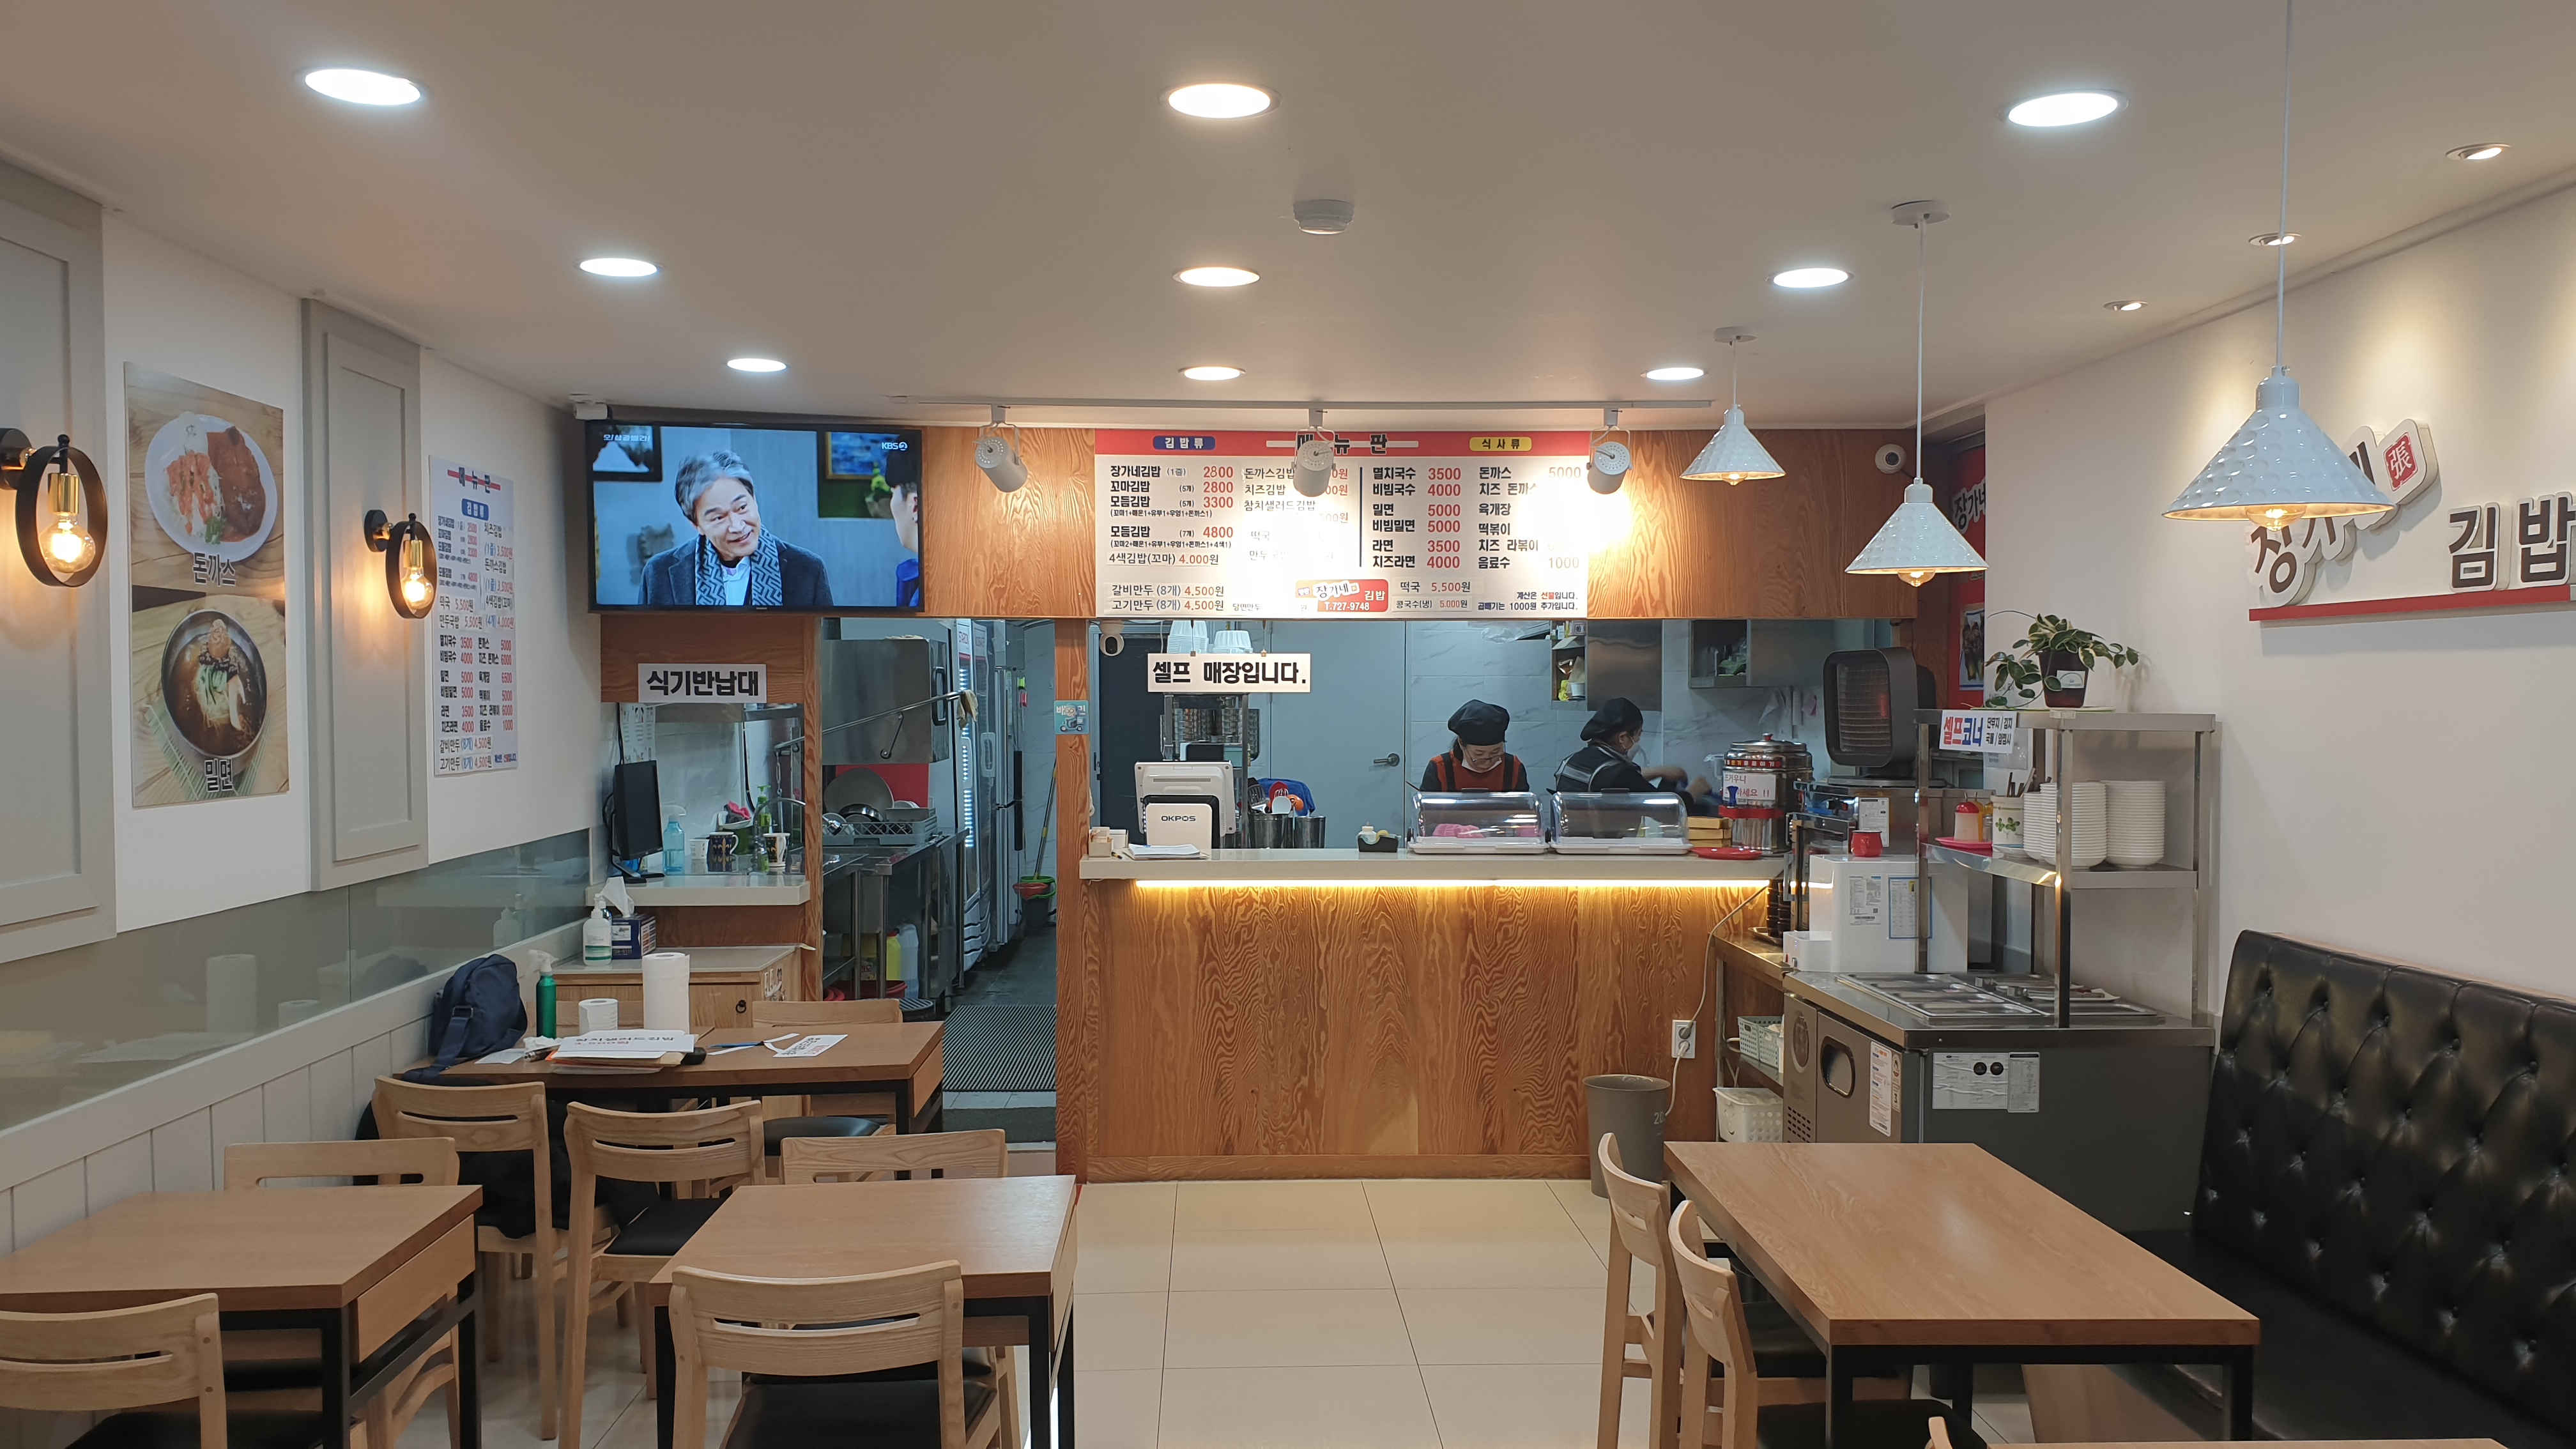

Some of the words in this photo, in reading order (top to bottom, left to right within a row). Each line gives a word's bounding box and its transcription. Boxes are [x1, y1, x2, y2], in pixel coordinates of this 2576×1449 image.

[1110, 466, 1161, 477] 장가네김밥
[1204, 466, 1233, 479] 2800
[1373, 467, 1416, 480] 멸치국수
[1428, 468, 1461, 480] 3500
[1479, 466, 1512, 479] 돈까스
[1549, 467, 1581, 479] 5000
[1110, 480, 1150, 493] 꼬마김밥
[1179, 484, 1194, 493] (5개)
[1203, 482, 1233, 493] 2800
[1245, 484, 1286, 496] 치즈김밥
[1373, 483, 1416, 496] 비빔국수
[1427, 484, 1461, 496] 4000
[1479, 483, 1500, 495] 치즈
[1110, 496, 1150, 508] 모듬김밥
[1179, 500, 1194, 508] (5개)
[1203, 497, 1233, 509] 3300
[1244, 500, 1316, 512] 참치샐러드김밥
[1373, 503, 1394, 516] 밀면
[1428, 504, 1460, 516] 5000
[1479, 503, 1511, 516] 육개장
[484, 522, 502, 538] 치즈김밥
[1373, 519, 1415, 532] 비빔밀면
[1428, 520, 1460, 532] 5000
[1478, 523, 1510, 535] 떡볶이
[1110, 526, 1150, 538] 모듬김밥
[1179, 530, 1194, 538] (7개)
[1203, 527, 1233, 539] 4800
[1373, 540, 1393, 552] 라면
[1427, 540, 1460, 553] 3500
[1478, 539, 1499, 551] 치즈
[1507, 539, 1538, 551] 라볶이
[2449, 496, 2576, 589] 김밥
[1109, 553, 1176, 566] 4색김밥(꼬마)
[1179, 554, 1218, 565] 4.000원
[1373, 555, 1415, 568] 치즈라면
[1427, 556, 1460, 569] 4000
[1478, 556, 1510, 569] 음료수
[1549, 557, 1579, 569] 1000
[192, 552, 236, 587] 돈까스
[1112, 585, 1153, 597] 갈비만두
[1156, 585, 1181, 597] (8개)
[1184, 586, 1224, 597] 4.500원
[1316, 583, 1349, 598] 장가네
[1364, 590, 1386, 601] 김밥
[1400, 581, 1420, 593] 떡국
[1431, 581, 1470, 593] 5.500원
[1517, 592, 1537, 600] 계산은
[1112, 600, 1153, 611] 고기만두
[1156, 600, 1181, 612] (8개)
[1184, 600, 1224, 611] 4.500원
[1324, 601, 1370, 611] T.727-9748
[1396, 600, 1432, 610] 콩국수(냉)
[1439, 600, 1468, 609] 5.000원
[461, 652, 473, 664] 4000
[461, 671, 473, 683] 5000
[1153, 661, 1191, 684] 셀프
[1203, 661, 1306, 684] 매장입니다.
[647, 670, 759, 696] 식기반납대
[461, 687, 473, 698] 5000
[461, 705, 473, 717] 3500
[462, 721, 474, 733] 4000
[503, 719, 513, 731] 1000
[1943, 716, 1984, 747] 셀프코너
[440, 739, 460, 753] 갈비만두
[440, 757, 460, 771] 고기만두
[204, 759, 233, 792] 밀면
